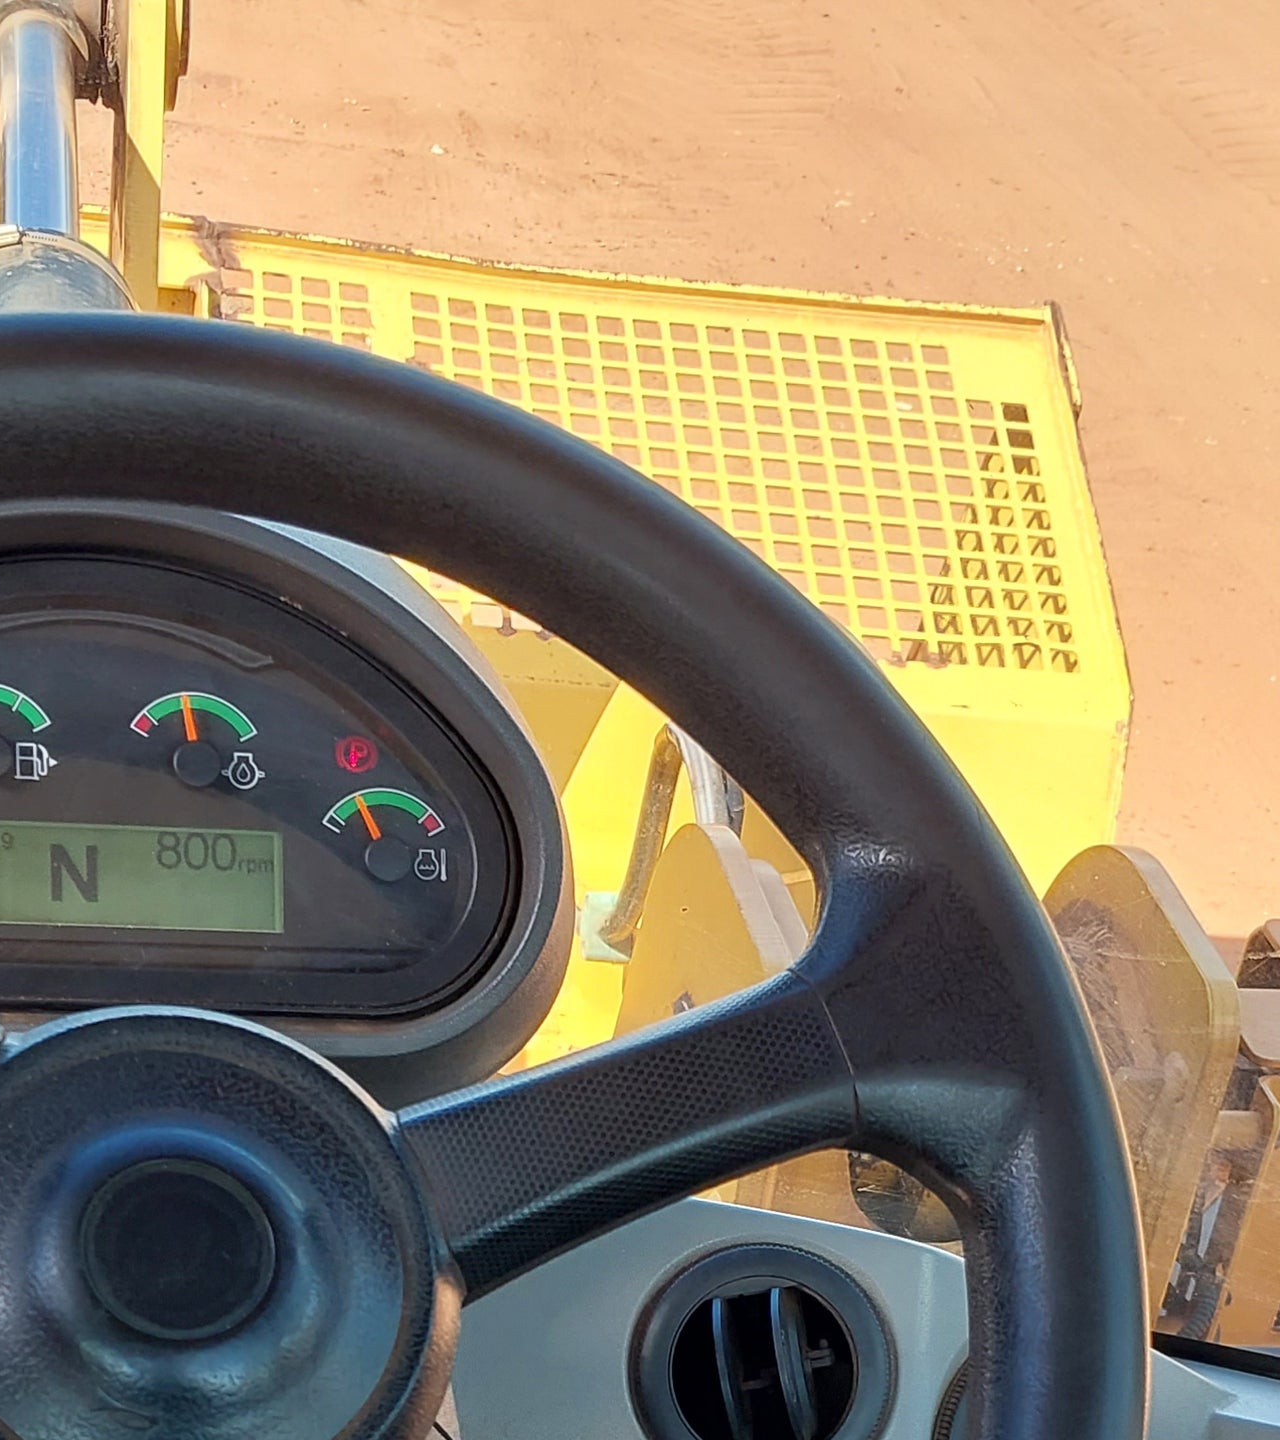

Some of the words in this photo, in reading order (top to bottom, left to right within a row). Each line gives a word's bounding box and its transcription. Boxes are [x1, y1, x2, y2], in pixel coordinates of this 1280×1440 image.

[49, 843, 99, 903] N
[157, 831, 237, 871] 800
[238, 859, 275, 874] rpm
